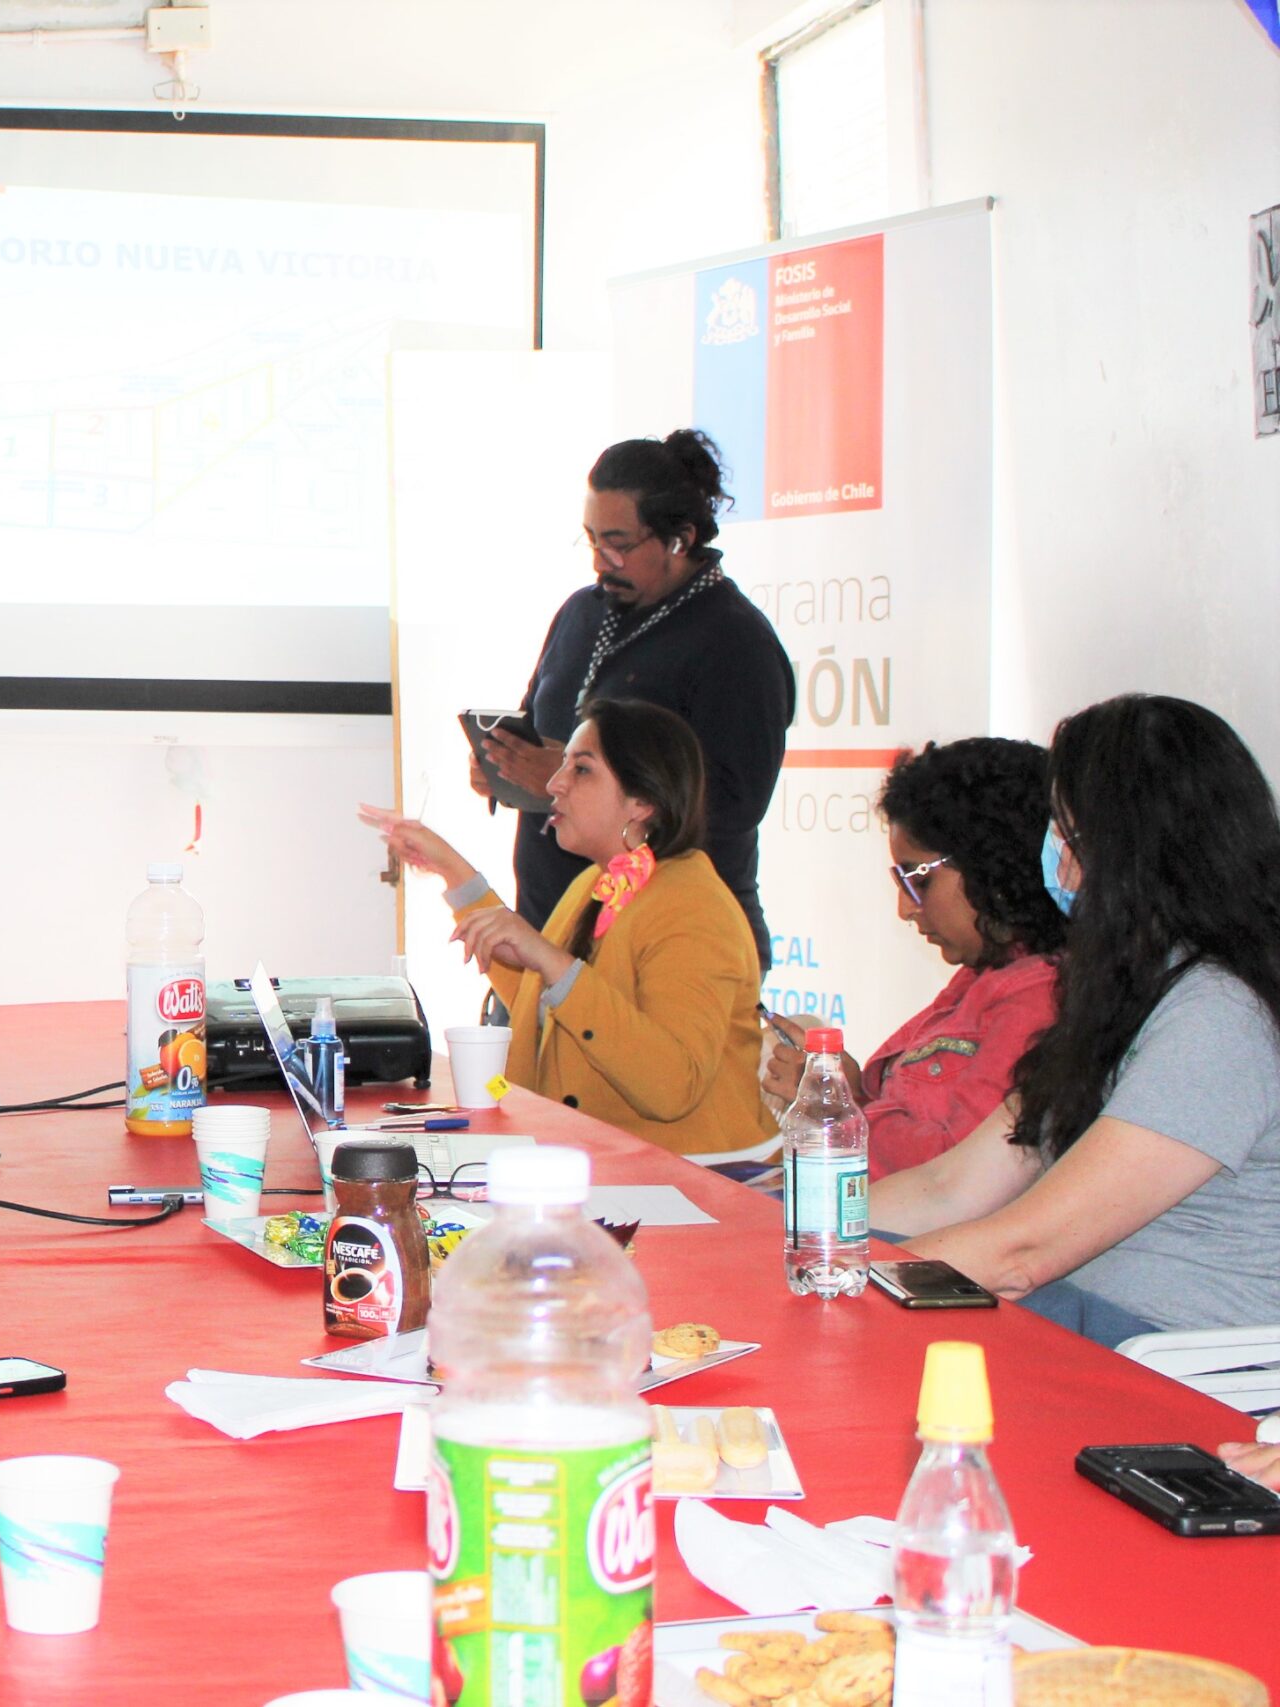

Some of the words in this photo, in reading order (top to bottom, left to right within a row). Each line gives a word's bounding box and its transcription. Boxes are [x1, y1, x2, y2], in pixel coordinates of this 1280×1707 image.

[115, 242, 245, 276] NUEVA
[256, 248, 440, 286] VICTORIA
[775, 261, 816, 287] FOSIS
[775, 289, 821, 307] Ministerio
[822, 285, 836, 299] de
[822, 299, 852, 316] Social
[774, 334, 781, 348] y
[782, 326, 816, 342] Familia
[771, 489, 824, 507] Gobierno
[824, 486, 839, 501] de
[841, 483, 874, 500] Chile
